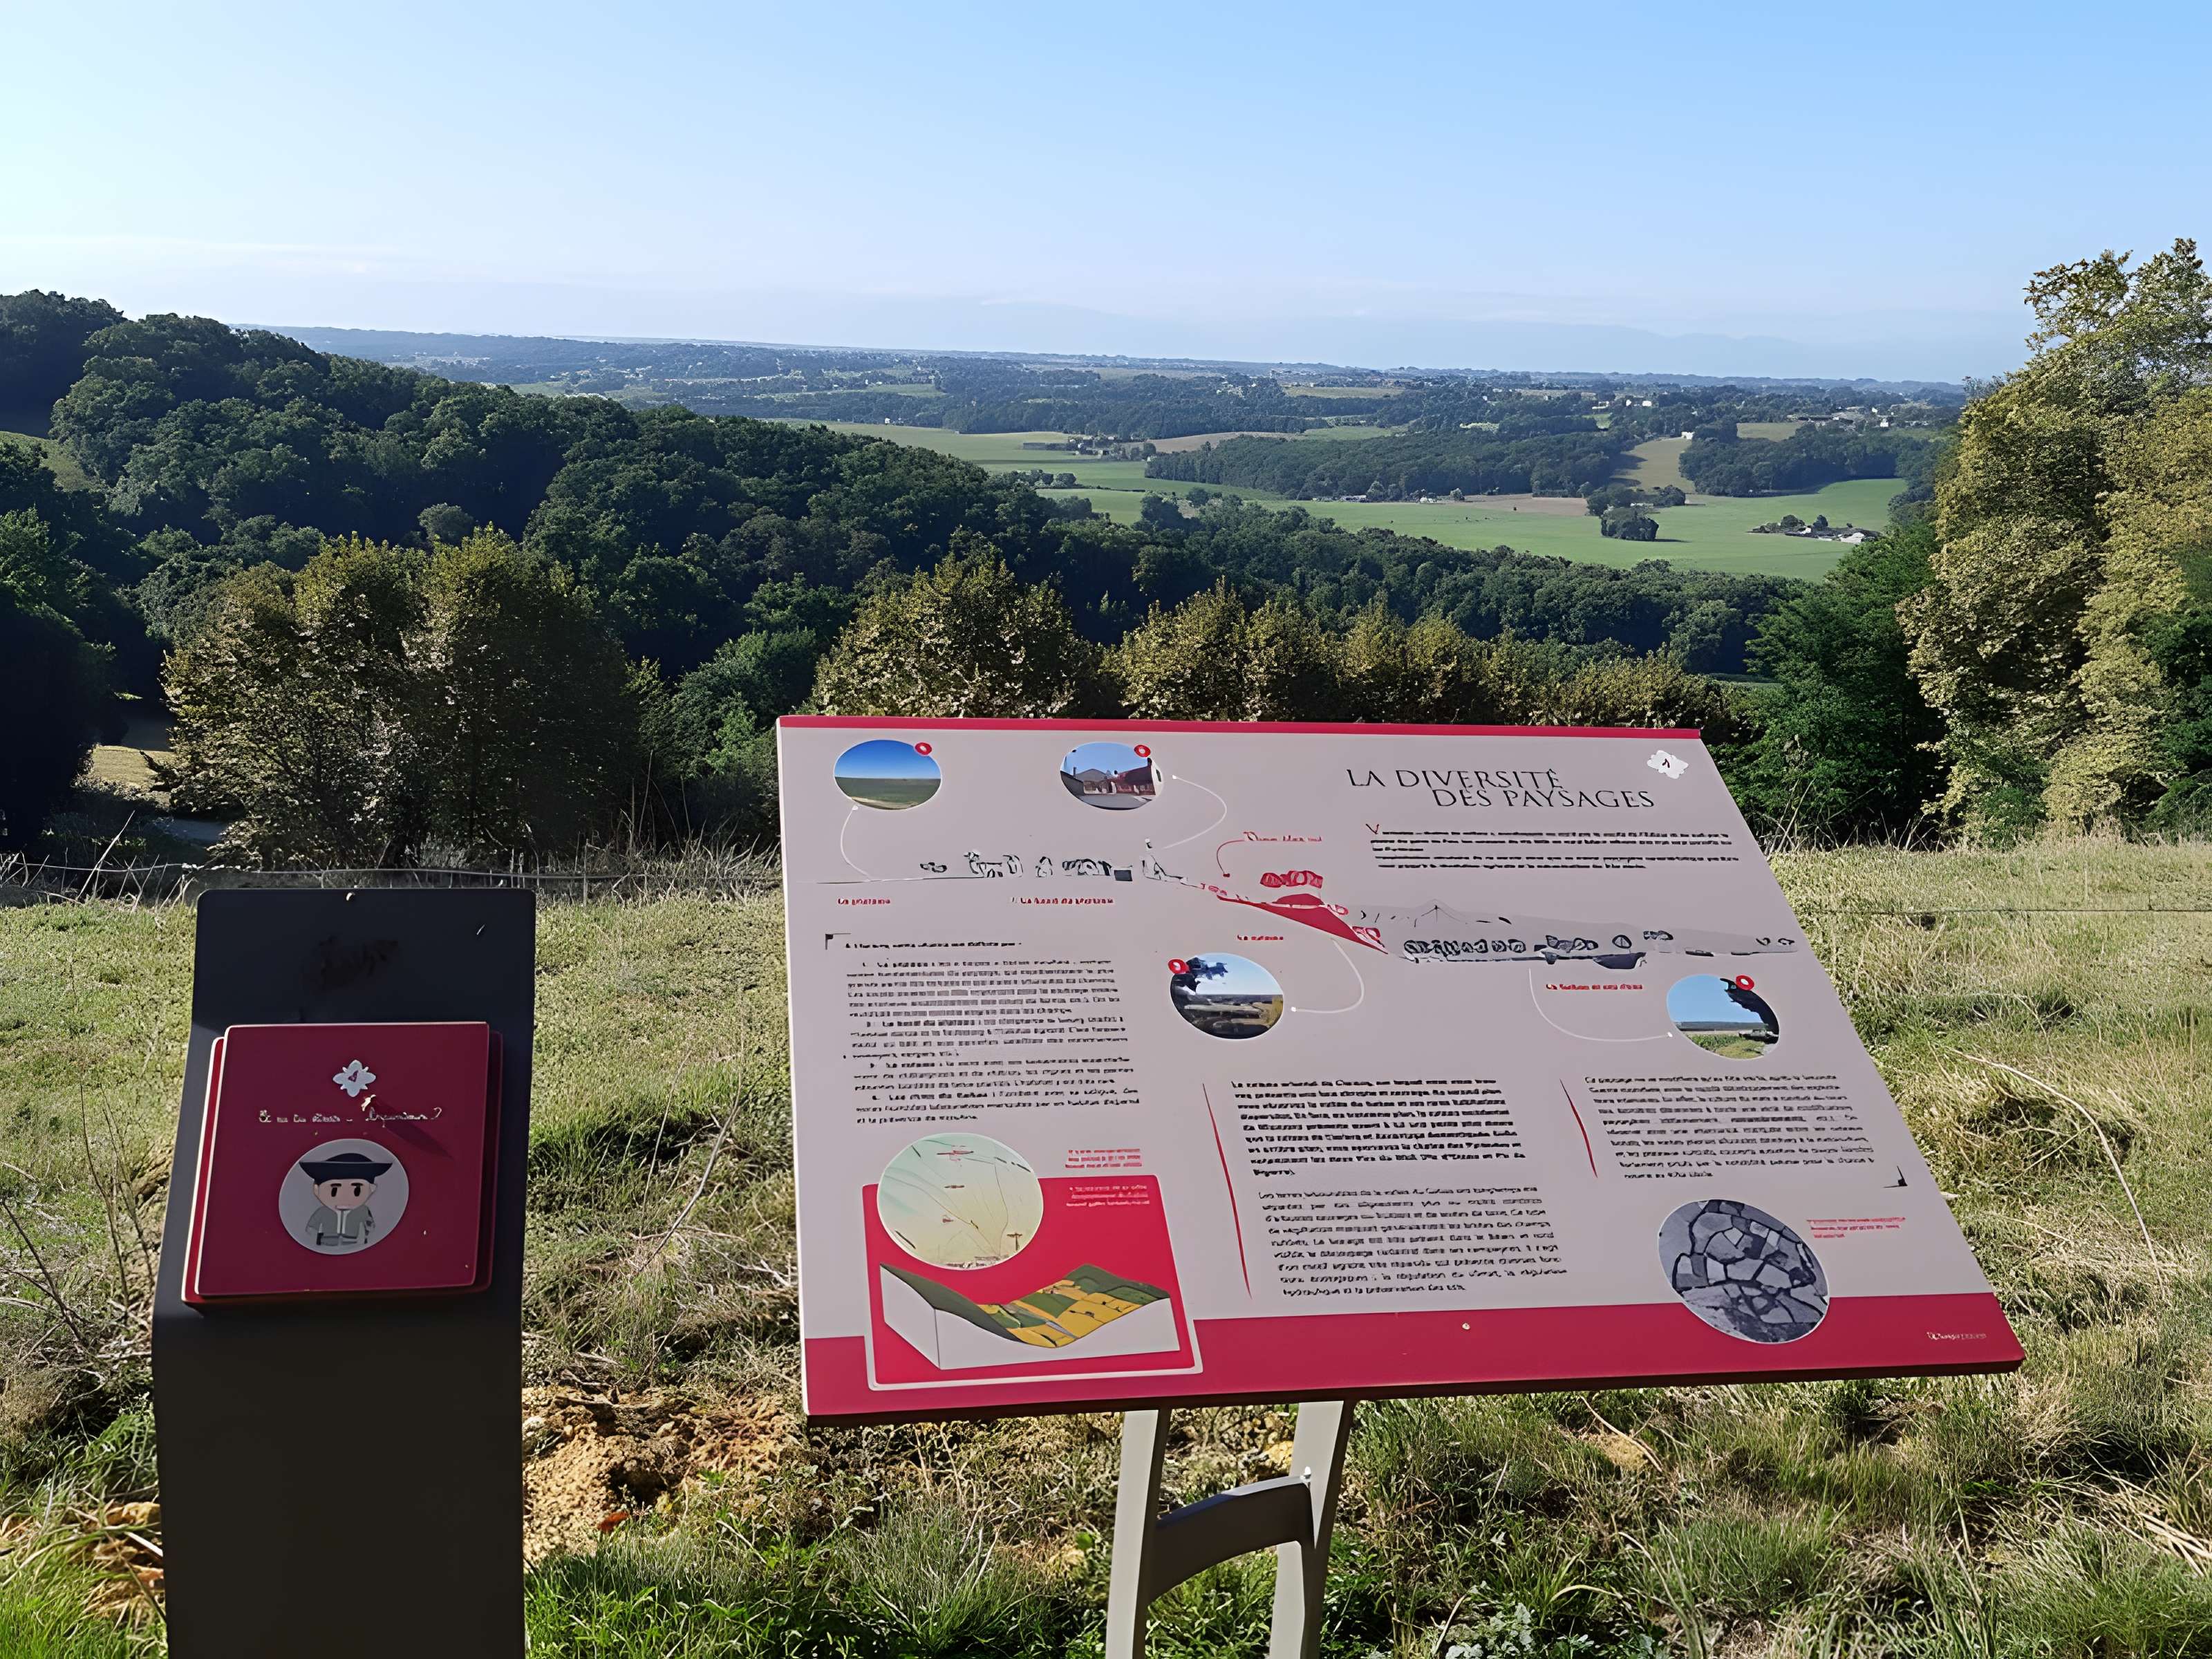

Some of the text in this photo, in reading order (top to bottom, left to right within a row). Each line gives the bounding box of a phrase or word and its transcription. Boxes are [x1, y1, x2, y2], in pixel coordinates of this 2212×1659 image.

[1347, 769, 1386, 787] LA
[1432, 789, 1655, 807] DES PAYSAGES
